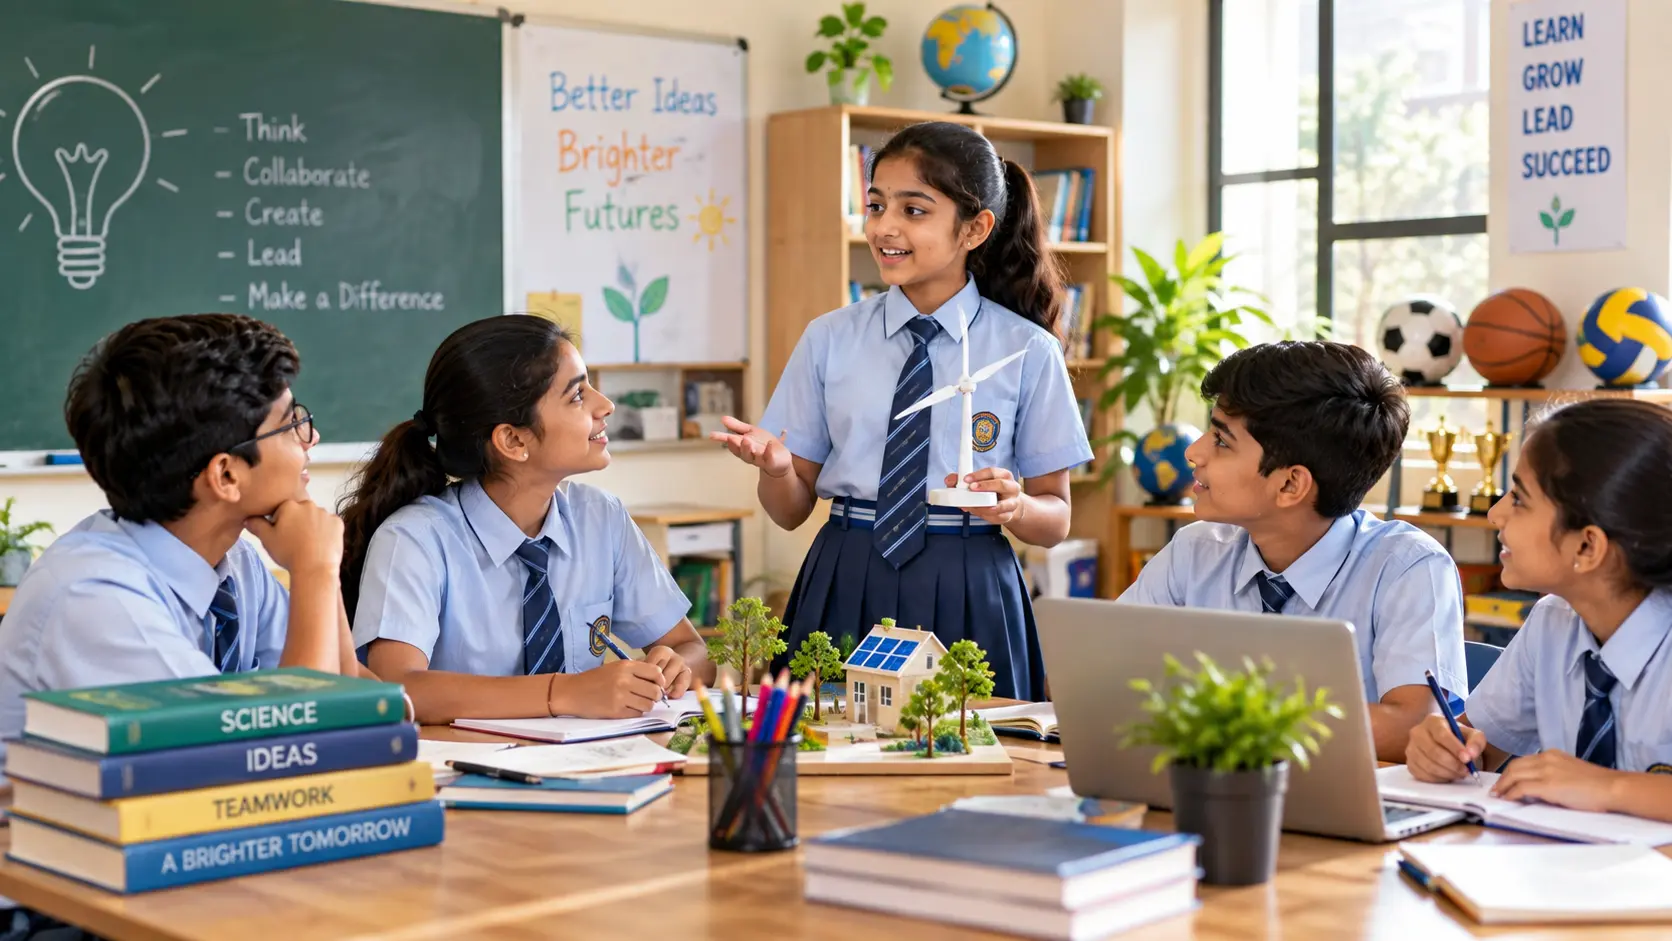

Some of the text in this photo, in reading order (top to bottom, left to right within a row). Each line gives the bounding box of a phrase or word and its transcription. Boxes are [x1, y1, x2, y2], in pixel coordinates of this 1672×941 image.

[1523, 13, 1584, 47] LEARN
[1523, 58, 1584, 91] GROW
[549, 71, 718, 117] Better Ideas
[239, 112, 307, 143] Think
[1523, 104, 1574, 135] LEAD
[243, 156, 370, 189] Collaborate
[557, 129, 682, 187] Brighter
[1522, 146, 1611, 180] SUCCEED
[244, 197, 324, 227] Create
[565, 189, 680, 233] Futures
[247, 238, 302, 267] Lead
[247, 280, 445, 311] Make a Difference
[220, 701, 318, 733] SCIENCE
[246, 742, 318, 773] IDEAS
[212, 785, 335, 820] TEAMWORK
[160, 816, 411, 876] A BRIGHTER TOMORROW
